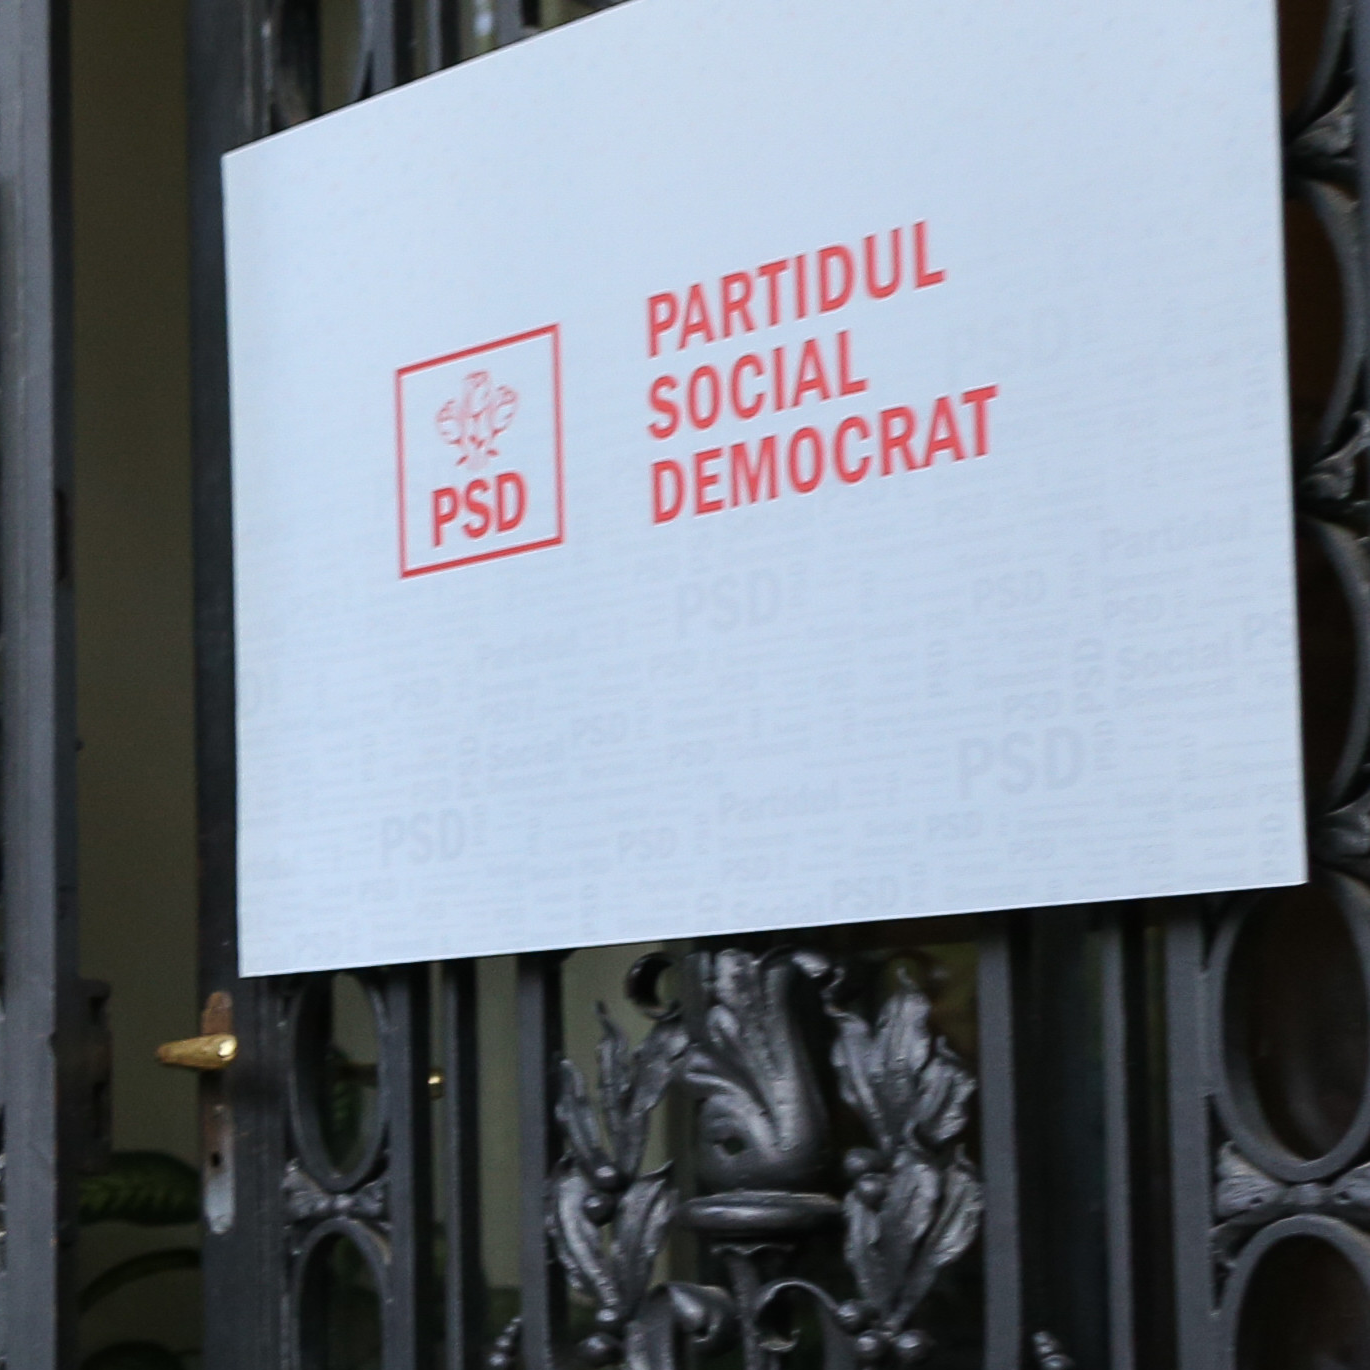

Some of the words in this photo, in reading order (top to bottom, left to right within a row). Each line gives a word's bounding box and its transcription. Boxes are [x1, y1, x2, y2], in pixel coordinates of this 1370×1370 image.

[647, 220, 947, 358] PARTIDUL
[648, 330, 869, 440] SOCIAL
[431, 471, 528, 548] PSD
[651, 385, 999, 525] DEMOCRAT
